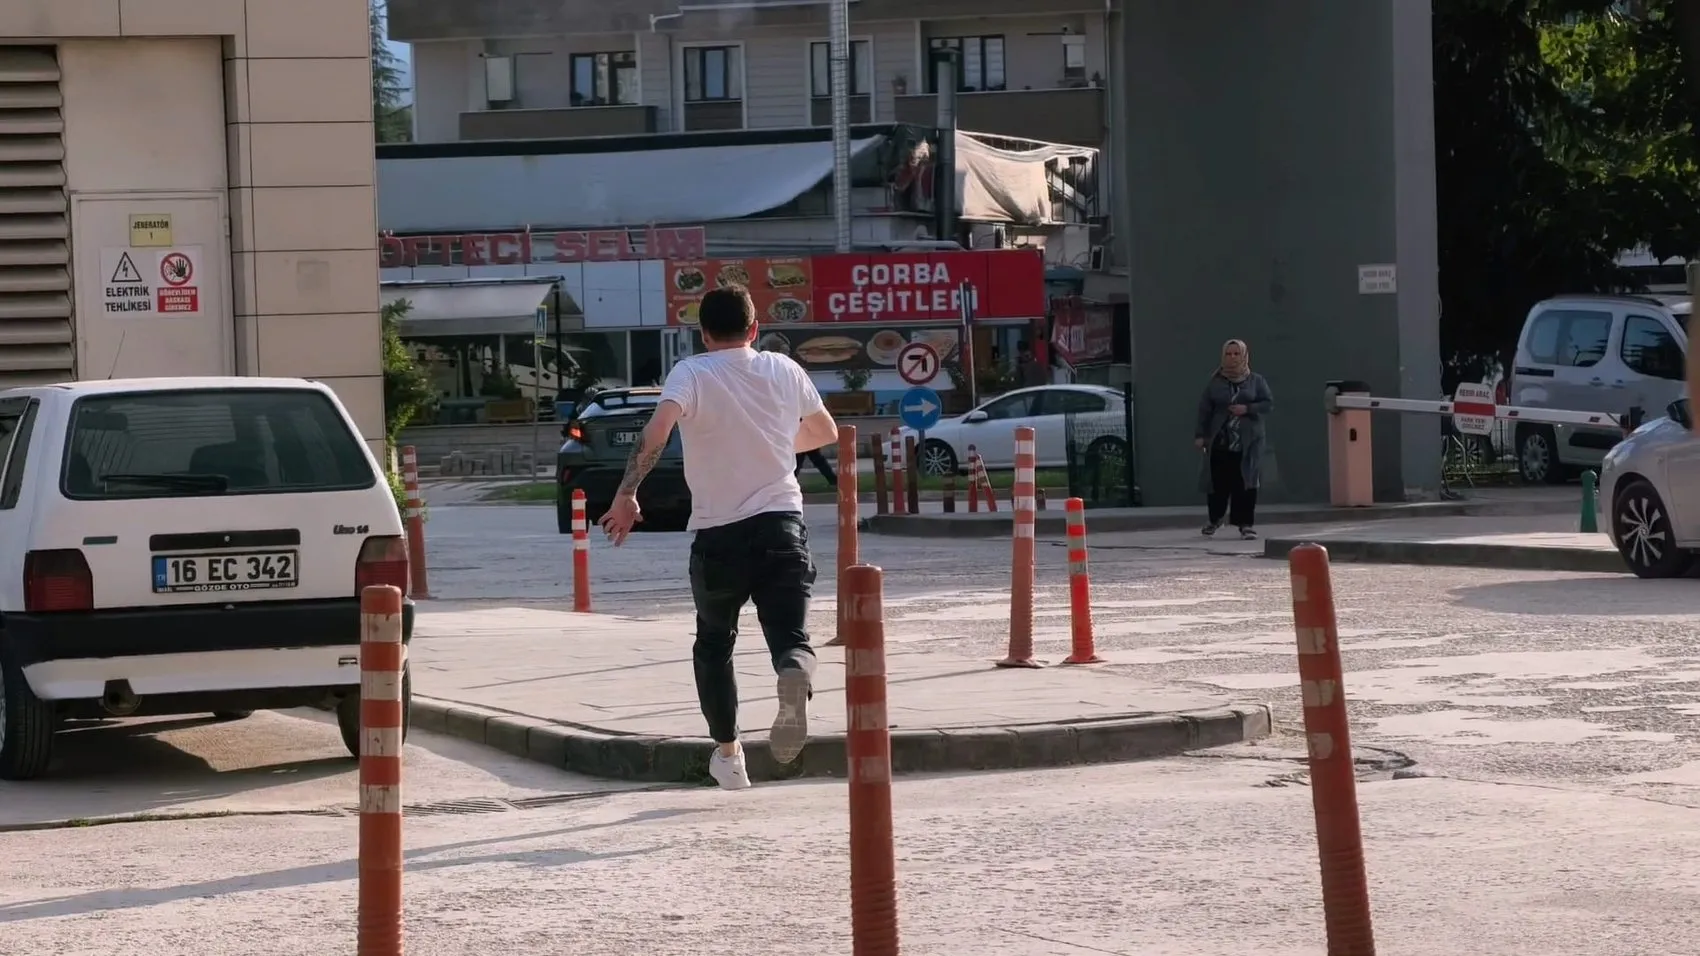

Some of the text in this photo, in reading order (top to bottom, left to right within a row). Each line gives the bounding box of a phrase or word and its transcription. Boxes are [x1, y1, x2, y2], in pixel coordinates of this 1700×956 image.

[133, 220, 169, 230] JENERATÖR
[553, 221, 706, 262] SELİM
[852, 262, 950, 291] ÇORBA
[105, 285, 150, 297] ELEKTRİK
[105, 299, 151, 312] TEHLİKESİ
[172, 556, 291, 583] 16 EC 342
[194, 583, 229, 592] GÖZDE
